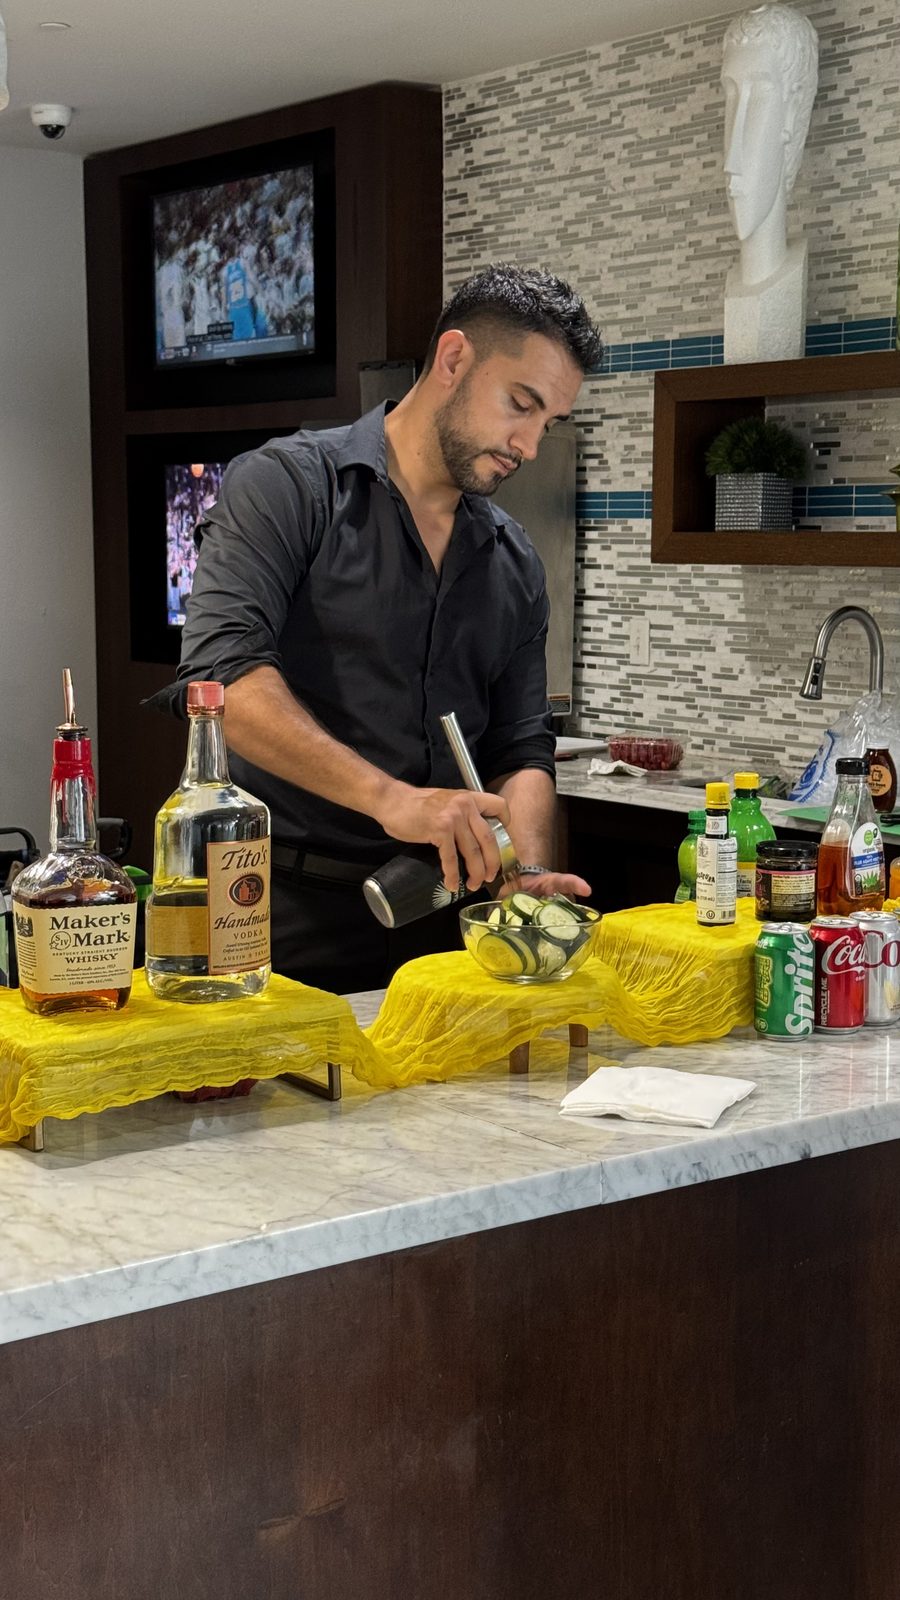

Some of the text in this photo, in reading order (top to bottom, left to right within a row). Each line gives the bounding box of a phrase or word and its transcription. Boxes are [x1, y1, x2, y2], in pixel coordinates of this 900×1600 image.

[221, 845, 267, 870] Tito's
[49, 912, 131, 930] Maker's
[214, 905, 269, 929] Handmad
[72, 929, 131, 948] Mark
[233, 929, 263, 939] VODKA
[65, 953, 118, 964] WHISKY
[785, 933, 815, 1036] Sprite
[820, 977, 828, 1026] RECYCLE ME
